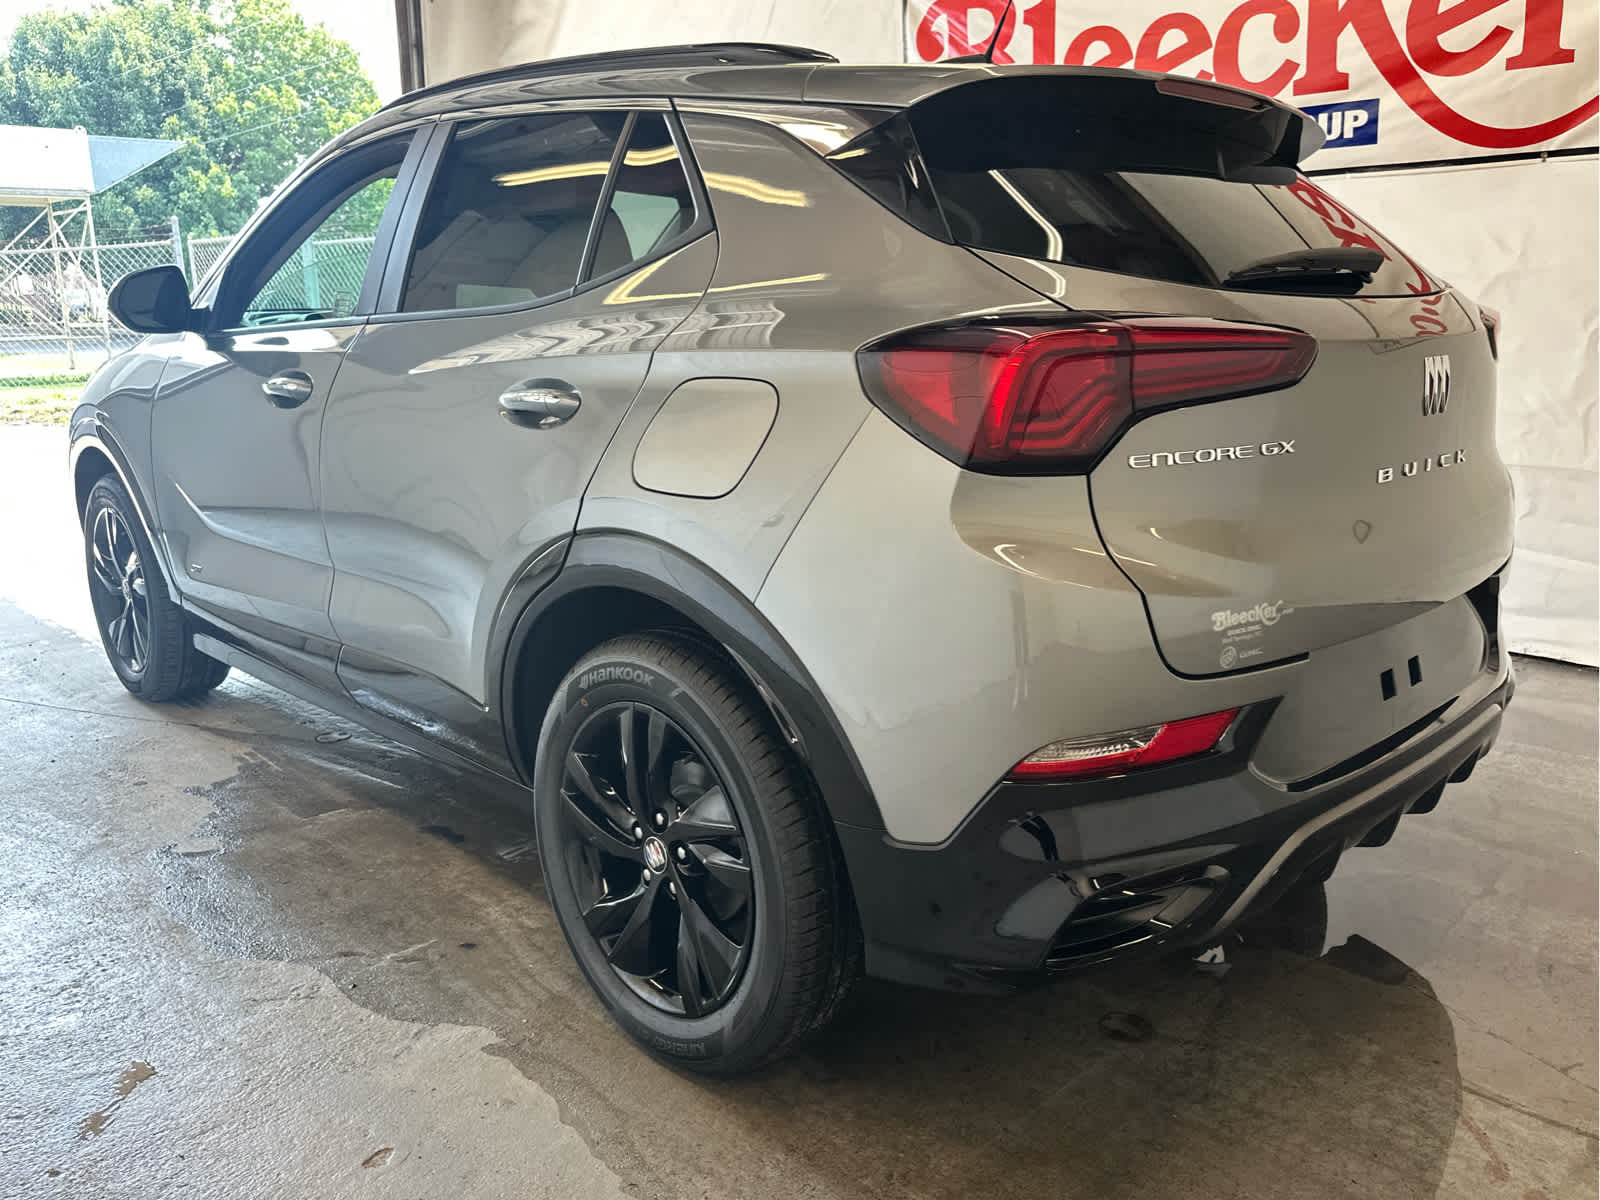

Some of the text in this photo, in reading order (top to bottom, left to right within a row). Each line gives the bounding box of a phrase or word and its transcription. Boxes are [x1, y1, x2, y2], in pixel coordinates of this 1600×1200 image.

[1128, 439, 1296, 469] ENCORE GX
[1376, 448, 1467, 484] BUICK
